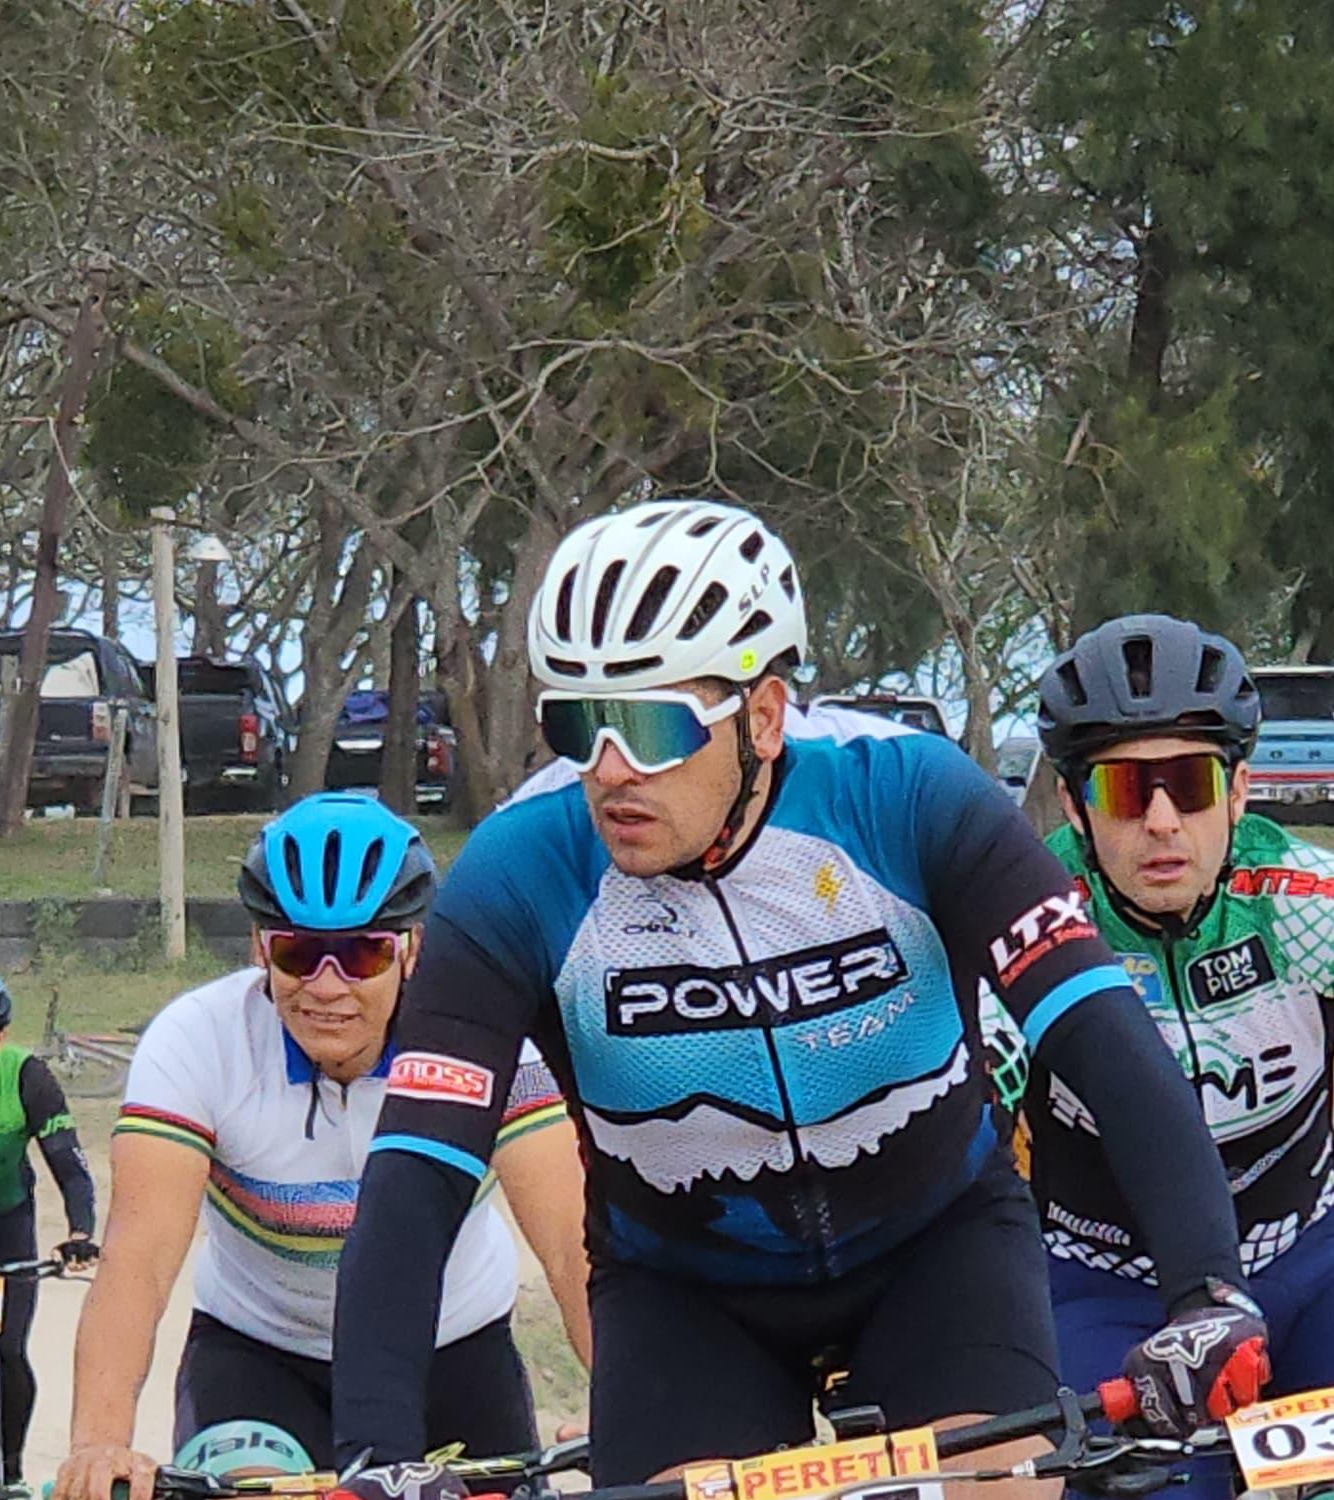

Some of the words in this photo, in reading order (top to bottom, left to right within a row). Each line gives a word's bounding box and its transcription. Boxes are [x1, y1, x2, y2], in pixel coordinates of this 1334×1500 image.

[989, 890, 1089, 975] LTX
[1197, 944, 1254, 977] TOM
[618, 942, 901, 1026] POWER
[1206, 963, 1260, 997] PIES
[795, 990, 916, 1051] TEAM
[742, 1442, 931, 1500] PERETTI
